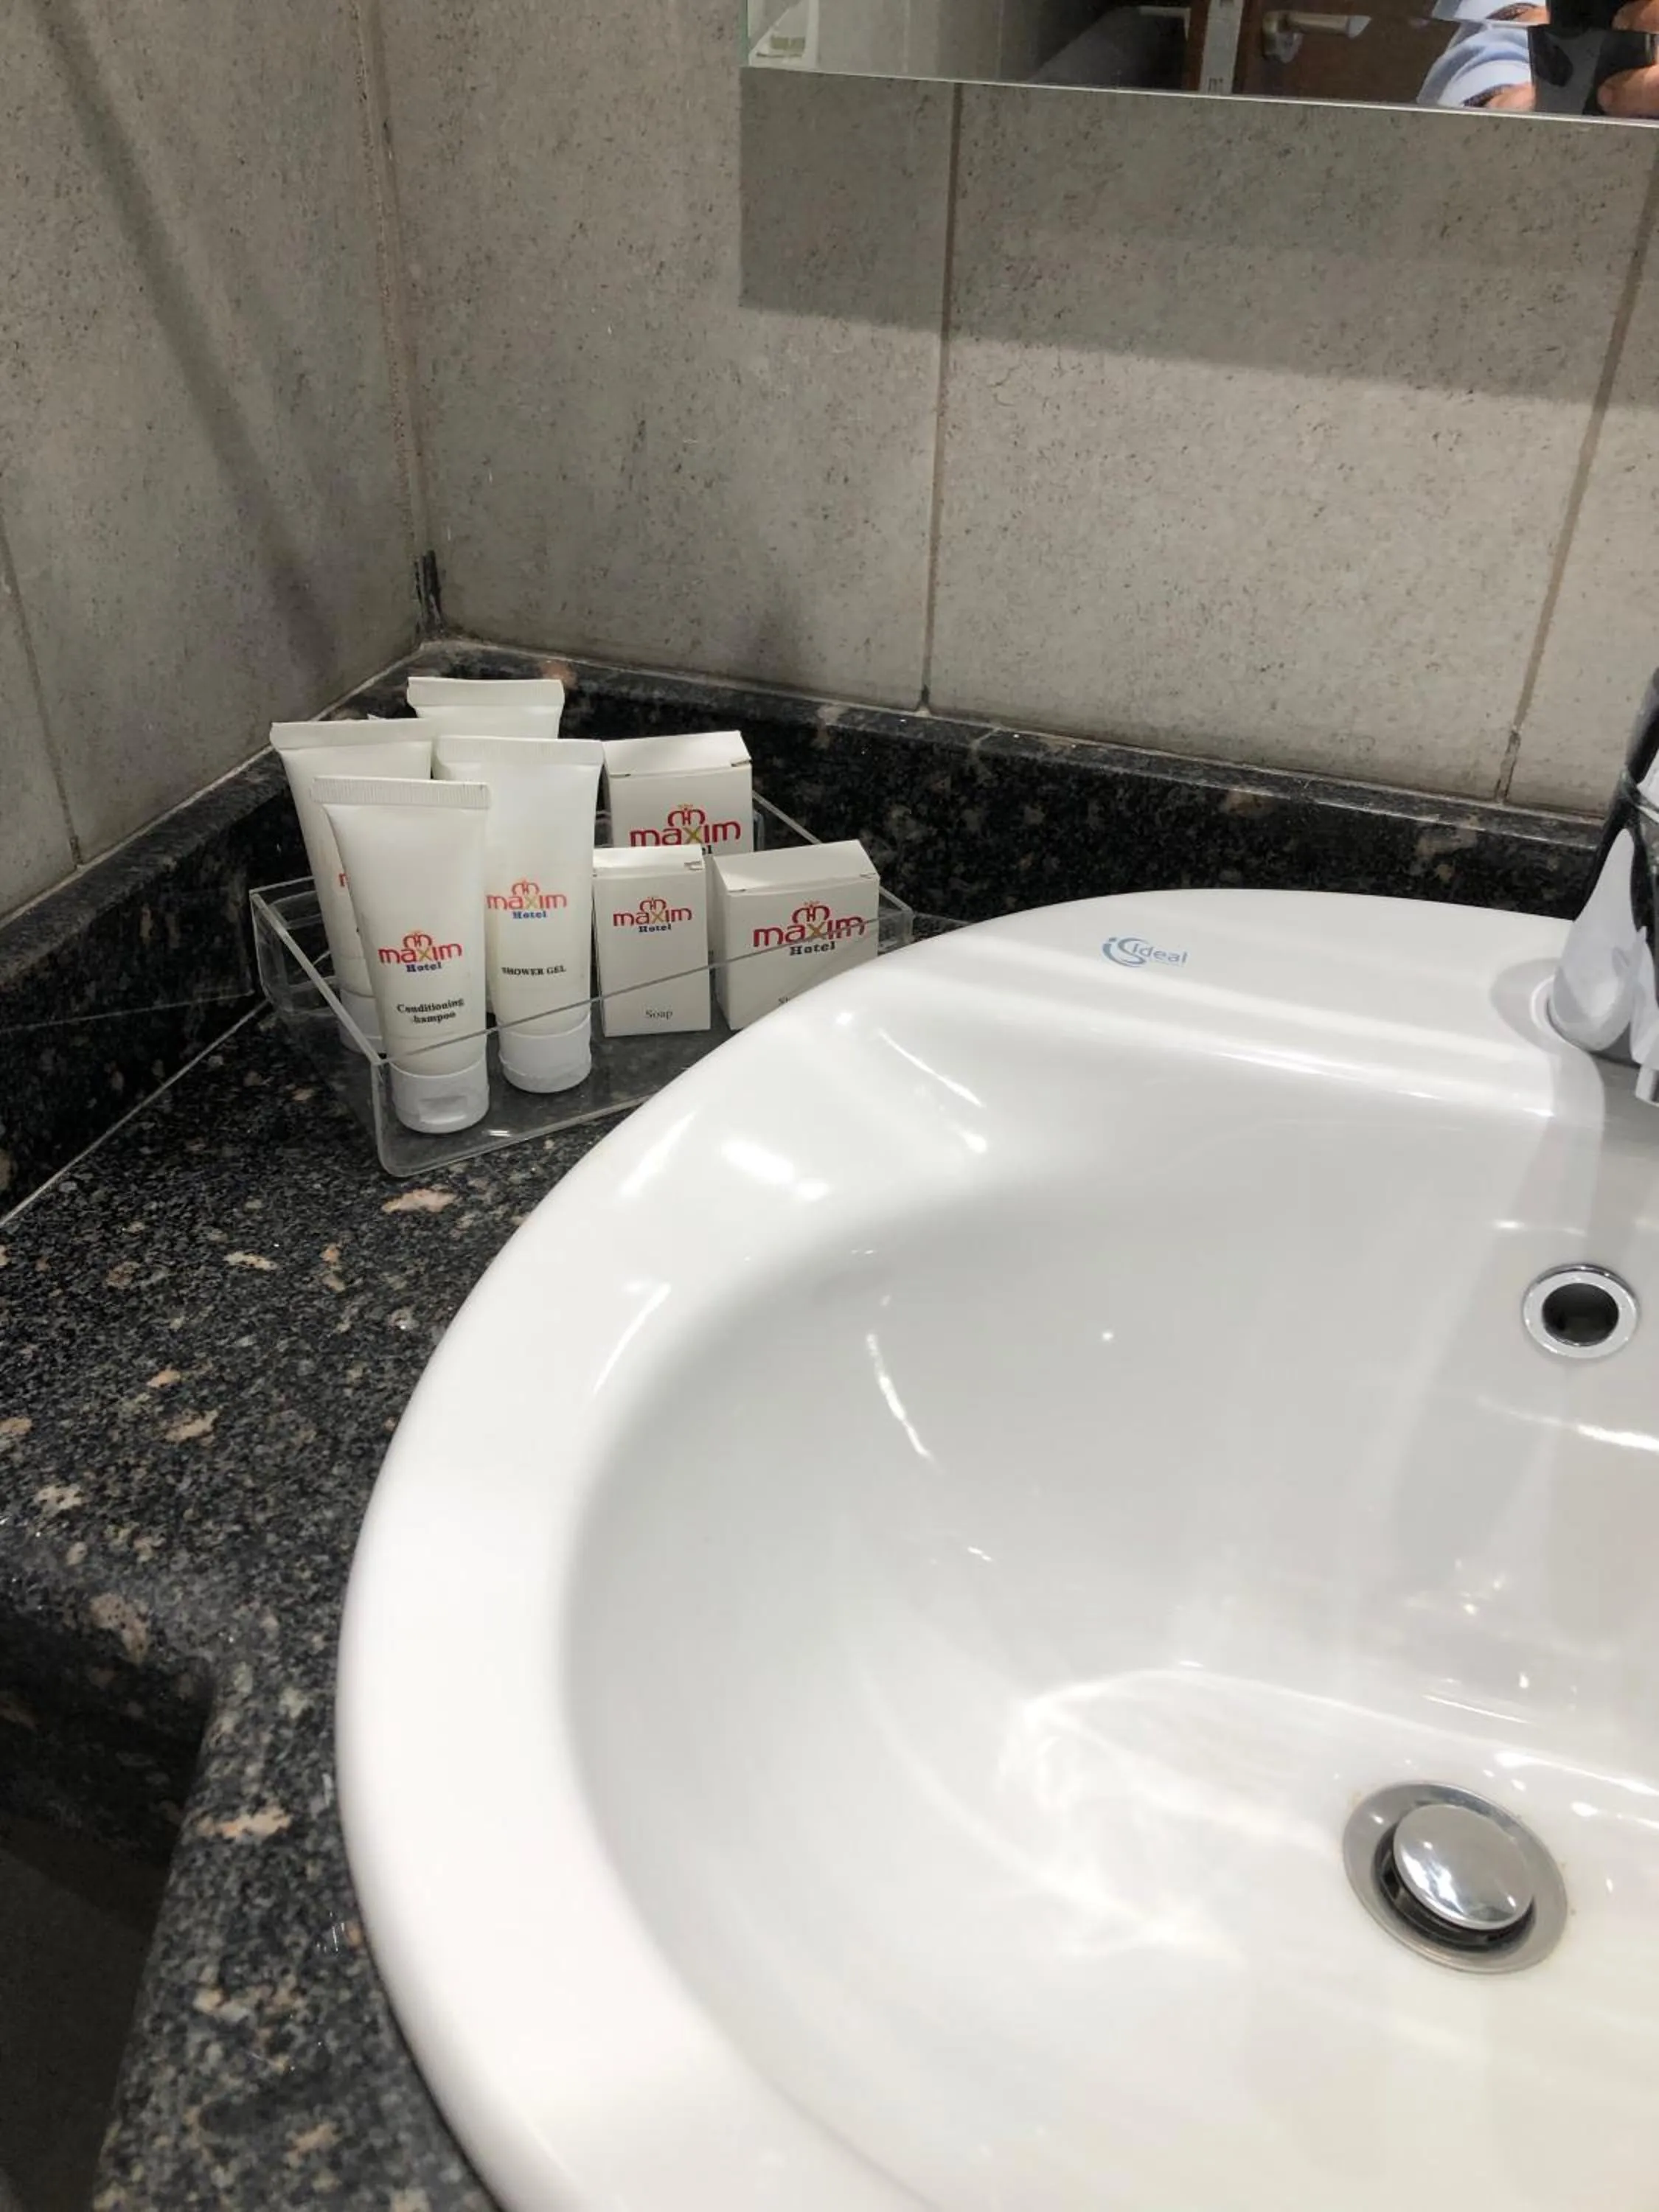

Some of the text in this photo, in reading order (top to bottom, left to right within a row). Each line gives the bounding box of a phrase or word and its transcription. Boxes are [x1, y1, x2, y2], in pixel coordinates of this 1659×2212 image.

[630, 821, 741, 846] maxim
[486, 894, 567, 909] maxim
[512, 911, 546, 919] Hotel
[613, 908, 692, 927] maxim
[639, 924, 672, 933] Hotel
[753, 917, 865, 947] maxim
[378, 943, 463, 964] maxim
[790, 941, 836, 956] Hotel
[406, 961, 442, 972] Hotel
[546, 964, 567, 974] GEL
[645, 1009, 673, 1020] Soap
